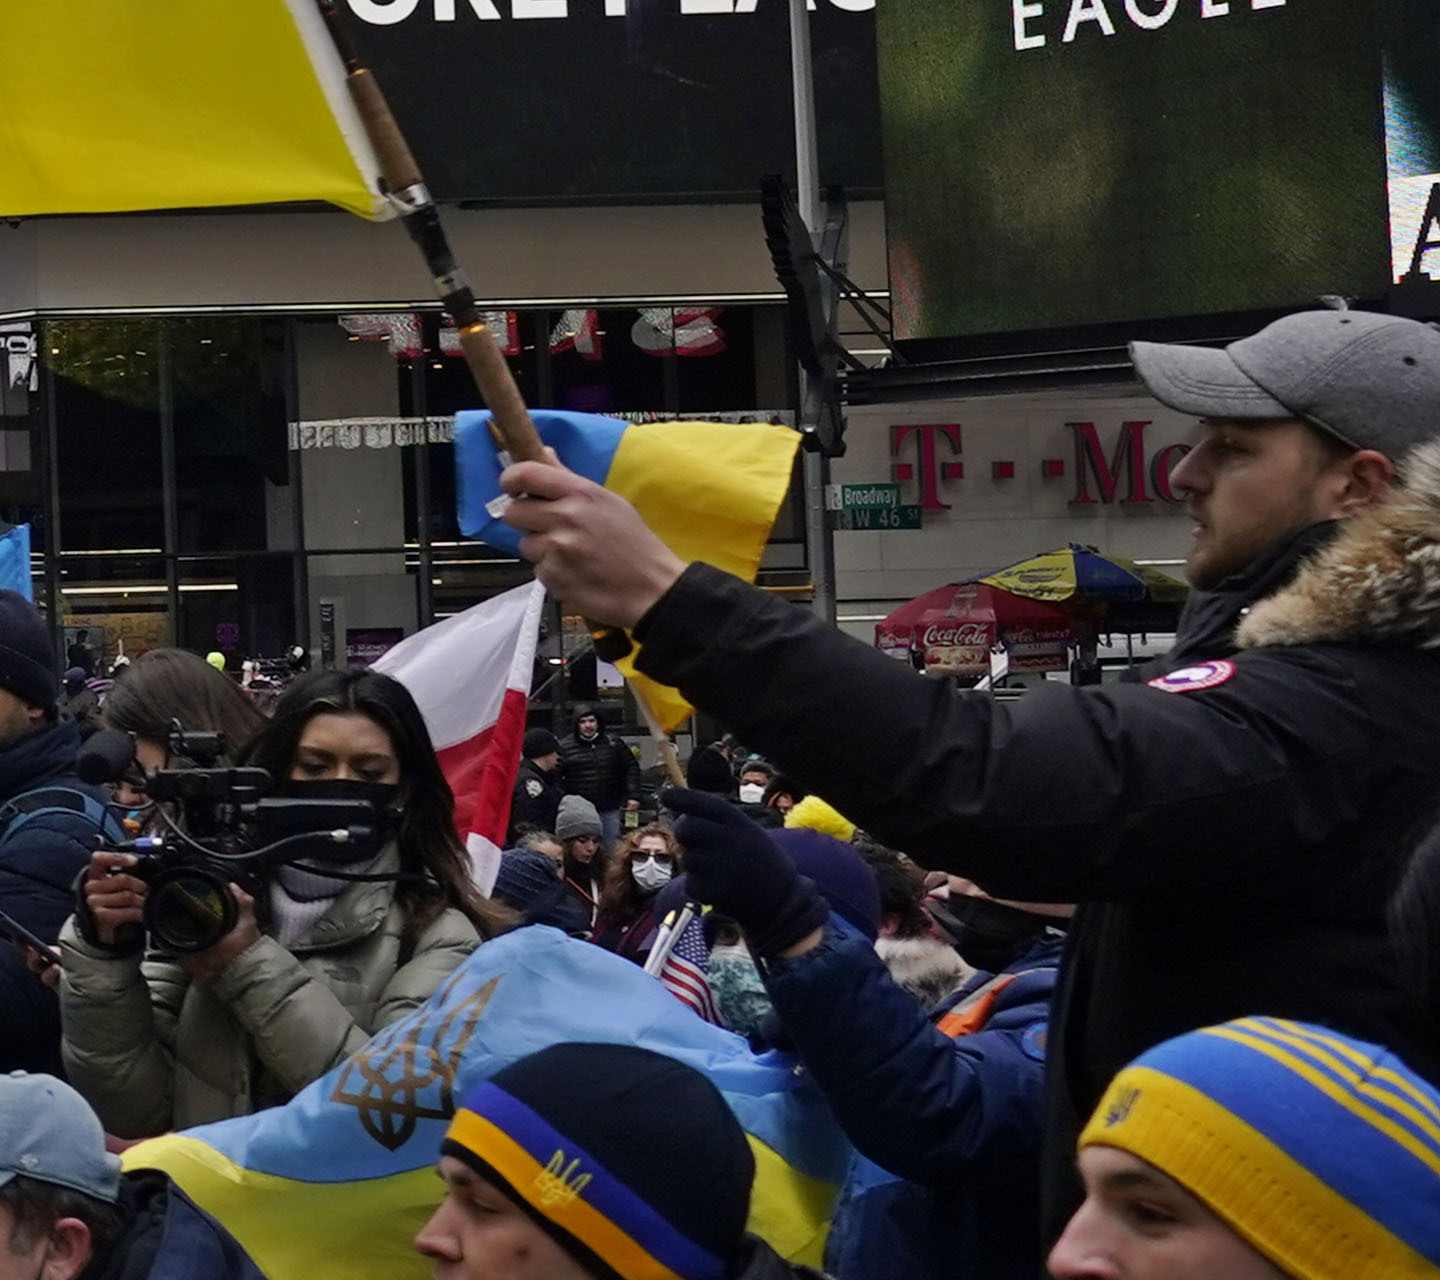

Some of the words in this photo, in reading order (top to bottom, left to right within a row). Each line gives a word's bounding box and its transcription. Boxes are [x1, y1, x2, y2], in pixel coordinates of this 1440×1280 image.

[845, 486, 897, 507] Broadway
[855, 511, 870, 527] W
[879, 510, 900, 527] 46
